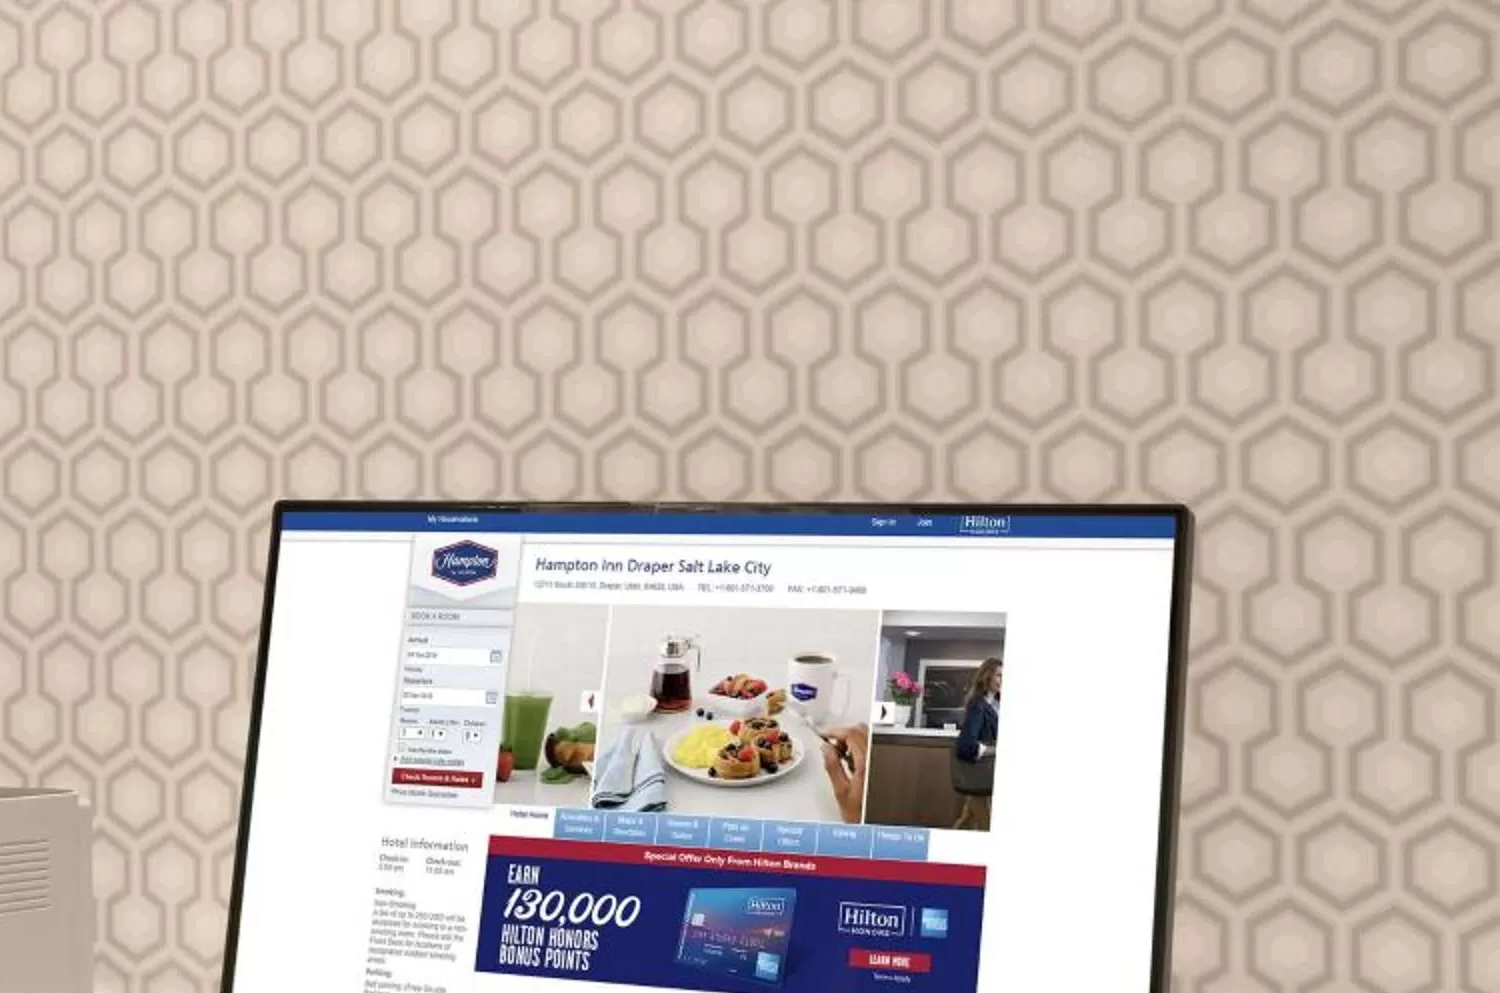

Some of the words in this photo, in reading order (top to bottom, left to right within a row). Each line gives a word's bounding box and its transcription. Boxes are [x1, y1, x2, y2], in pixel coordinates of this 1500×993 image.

[965, 515, 1006, 529] Hilton
[435, 552, 494, 571] Hampton
[535, 557, 599, 575] Hampton
[602, 558, 623, 572] Inn
[627, 558, 674, 575] Draper
[678, 559, 704, 574] Salt
[707, 560, 741, 574] Lake
[744, 560, 772, 577] City
[381, 835, 408, 848] Hotel
[644, 851, 676, 863] Special
[678, 852, 702, 865] Offer
[704, 854, 725, 867] Only
[727, 855, 751, 867] From
[753, 857, 780, 869] Hilton
[783, 859, 817, 871] Brands
[507, 863, 541, 885] EARN
[503, 887, 641, 927] 130,000
[844, 907, 899, 929] Hilton
[501, 923, 545, 946] HILTON
[548, 927, 600, 951] HONORS
[499, 944, 541, 967] BONUS
[544, 948, 591, 971] POINTS
